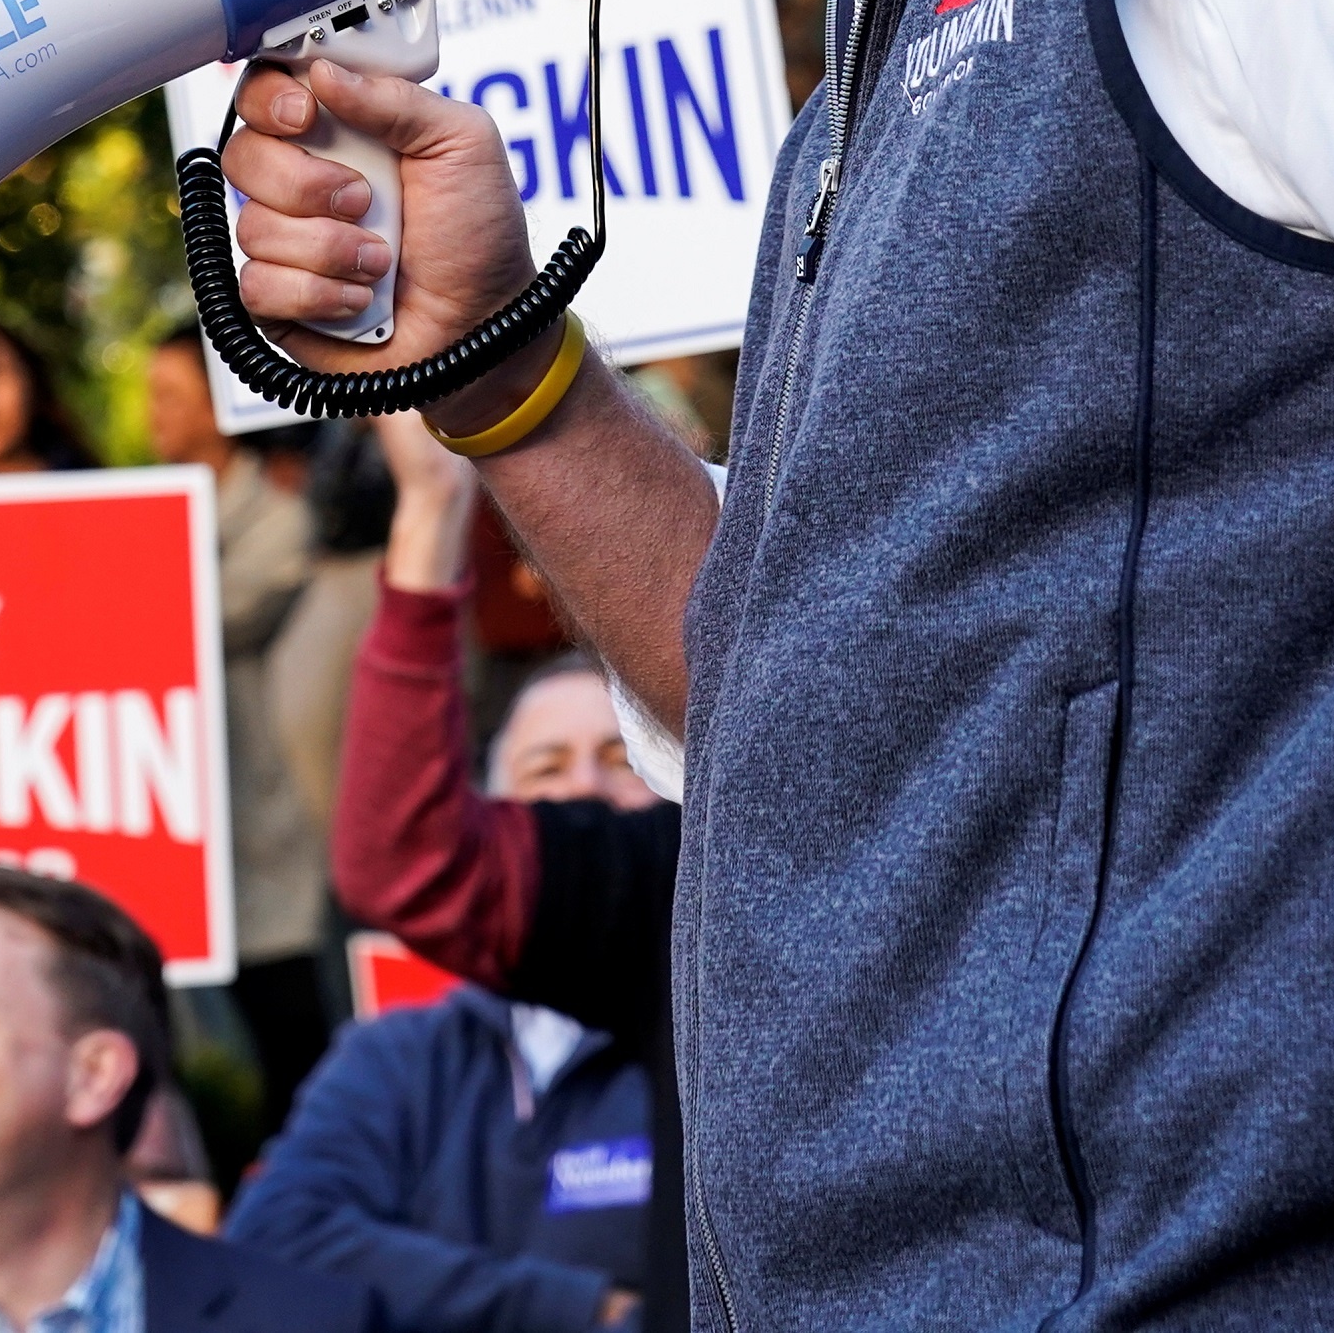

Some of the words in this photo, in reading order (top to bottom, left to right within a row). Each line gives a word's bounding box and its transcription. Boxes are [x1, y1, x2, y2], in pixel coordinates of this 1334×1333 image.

[308, 9, 332, 24] SIREN
[337, 0, 353, 12] OFF
[441, 28, 746, 203] GKIN
